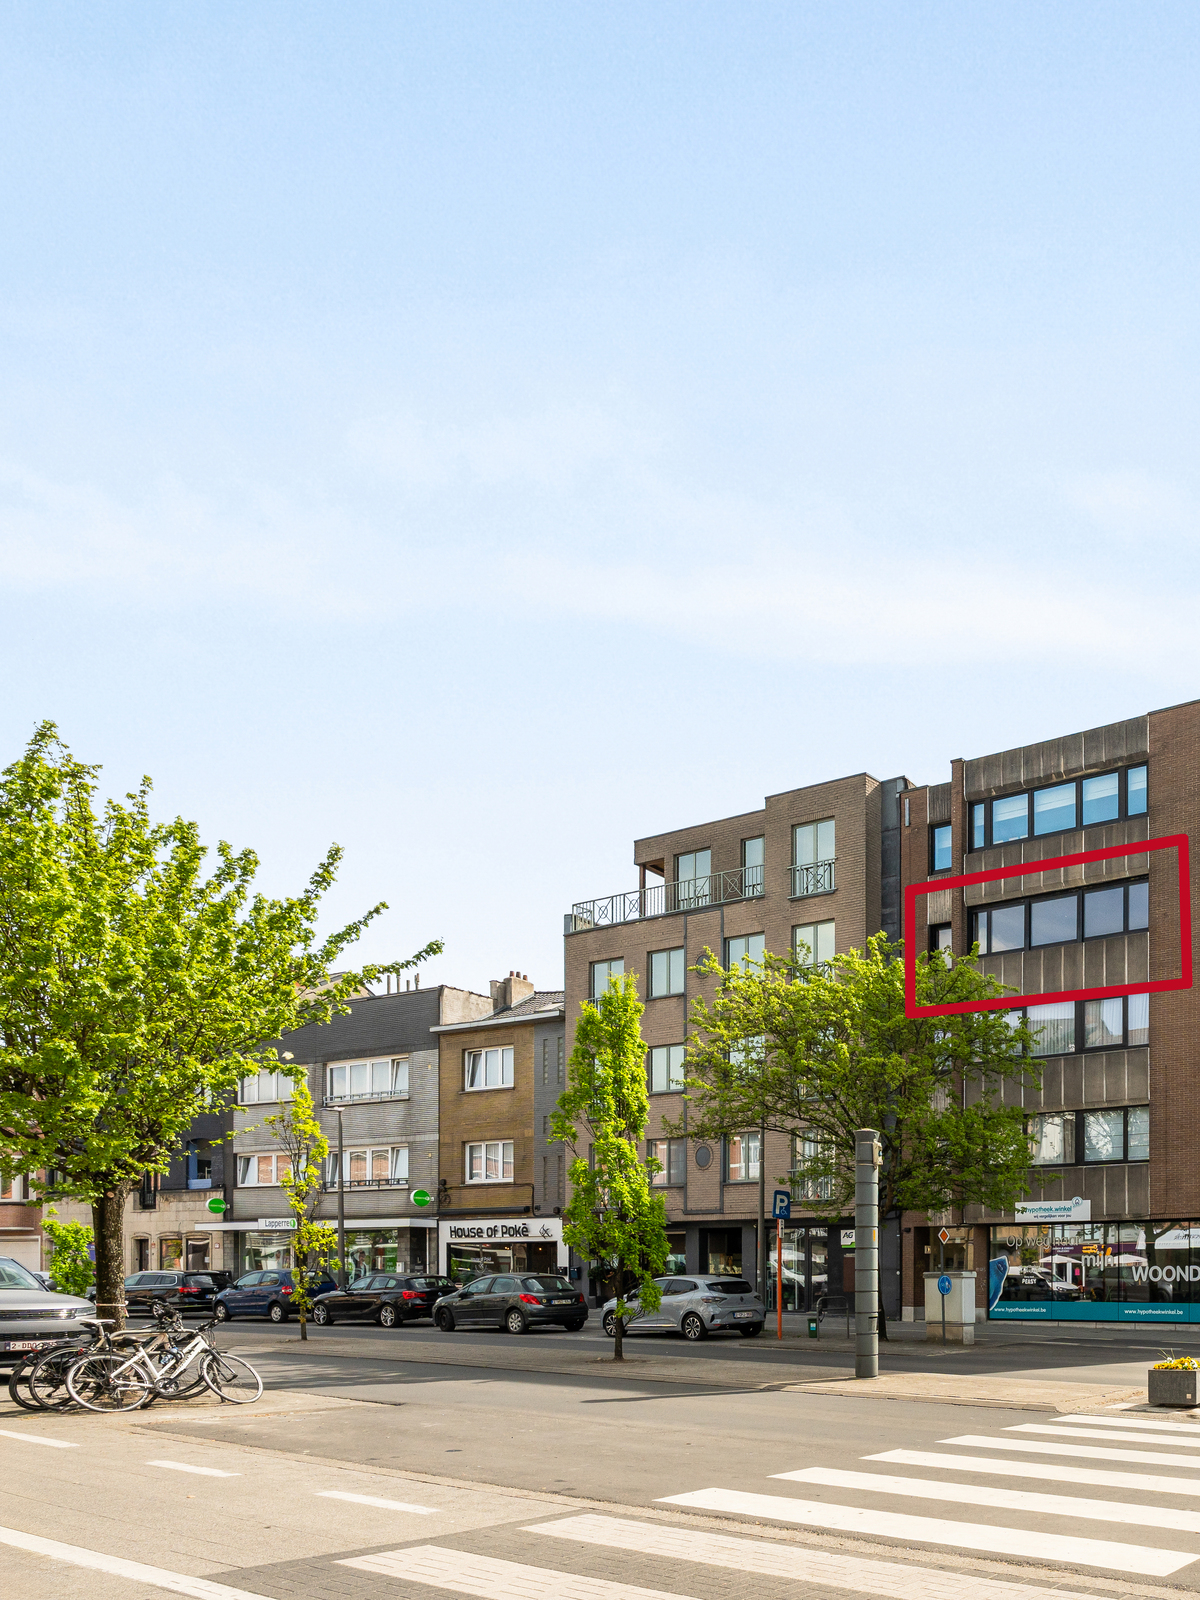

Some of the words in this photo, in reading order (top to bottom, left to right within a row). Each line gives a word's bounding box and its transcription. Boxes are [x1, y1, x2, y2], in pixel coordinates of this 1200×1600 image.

[775, 1194, 788, 1214] P
[265, 1219, 290, 1228] Lapperre
[450, 1226, 484, 1238] House
[486, 1225, 499, 1237] of
[1006, 1235, 1023, 1250] Op
[1081, 1250, 1114, 1271] mijn
[1123, 1308, 1184, 1316] www.hypotheekwinkel.be
